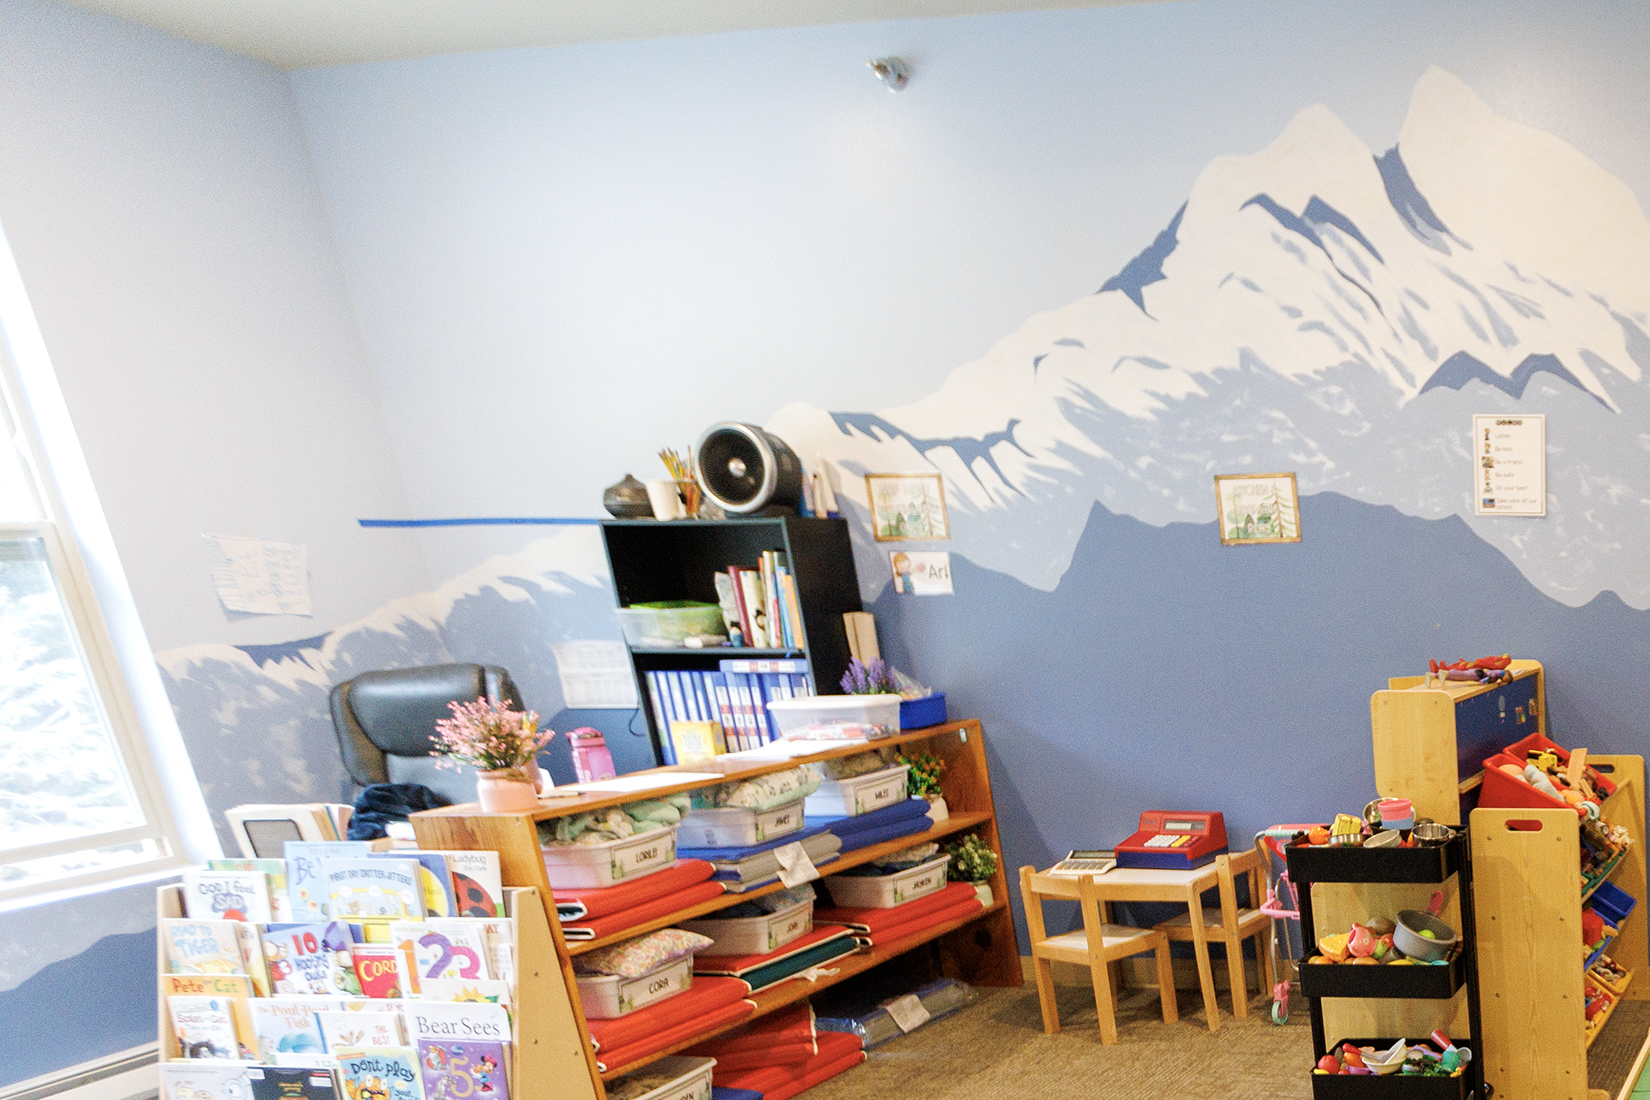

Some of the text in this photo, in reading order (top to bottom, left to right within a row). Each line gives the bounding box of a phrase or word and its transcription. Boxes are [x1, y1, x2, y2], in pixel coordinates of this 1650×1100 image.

[291, 932, 318, 956] 10
[172, 977, 204, 993] Pete
[214, 979, 239, 993] Cat
[648, 977, 669, 995] CORA
[285, 1017, 311, 1028] Fish
[416, 1015, 501, 1036] Bear Sees
